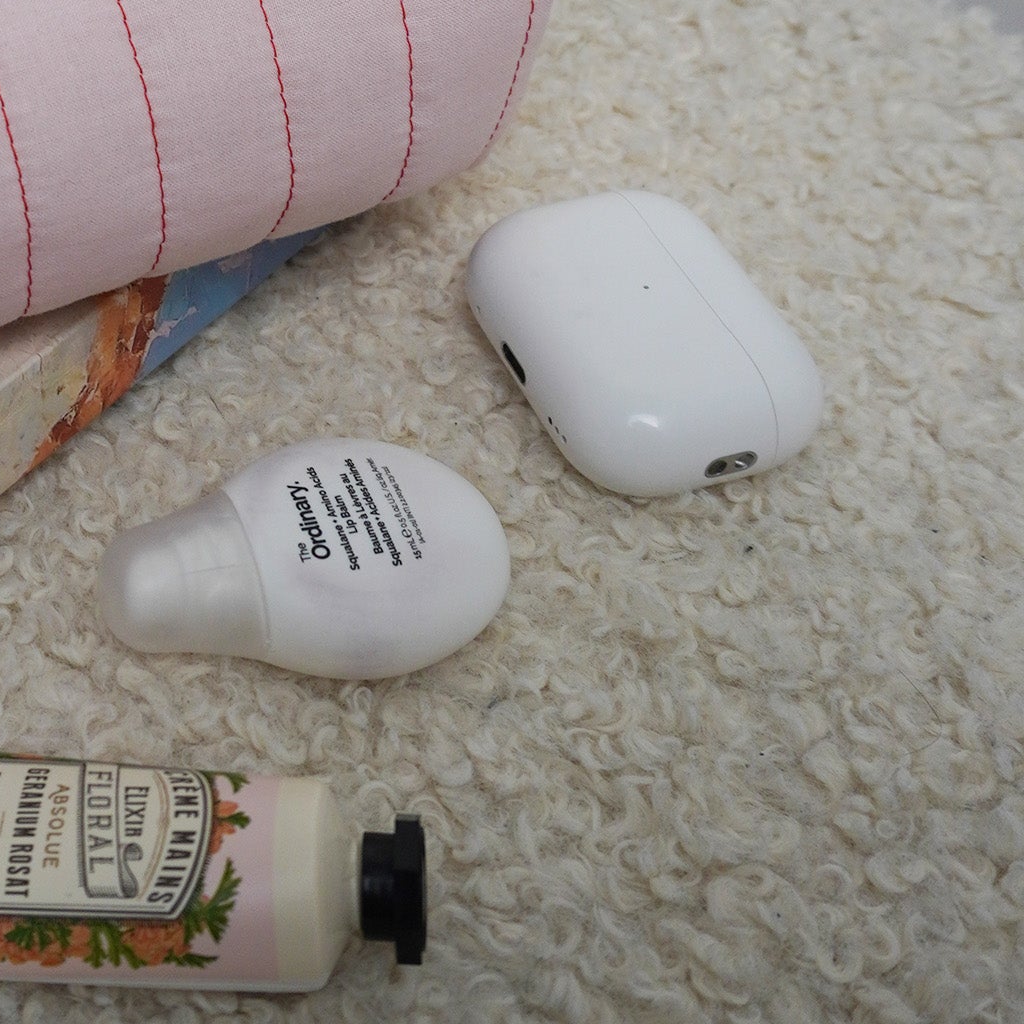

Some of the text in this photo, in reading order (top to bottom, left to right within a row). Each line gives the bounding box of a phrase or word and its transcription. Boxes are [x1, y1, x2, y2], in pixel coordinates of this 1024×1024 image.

[339, 473, 351, 484] au
[345, 484, 366, 513] Lèvres
[360, 488, 380, 516] Acides
[287, 480, 331, 560] Ordinary.
[306, 466, 360, 571] Squalane Amino Acids
[334, 494, 358, 535] Lip Balm
[363, 520, 384, 555] Baume
[297, 542, 311, 563] The
[377, 521, 403, 567] Squalane
[4, 768, 50, 898] GERANIUM ROSAT
[42, 783, 70, 869] ABSOLUE
[87, 770, 115, 874] FLORAL
[124, 786, 150, 837] ELIXIR
[147, 830, 196, 904] MAINS
